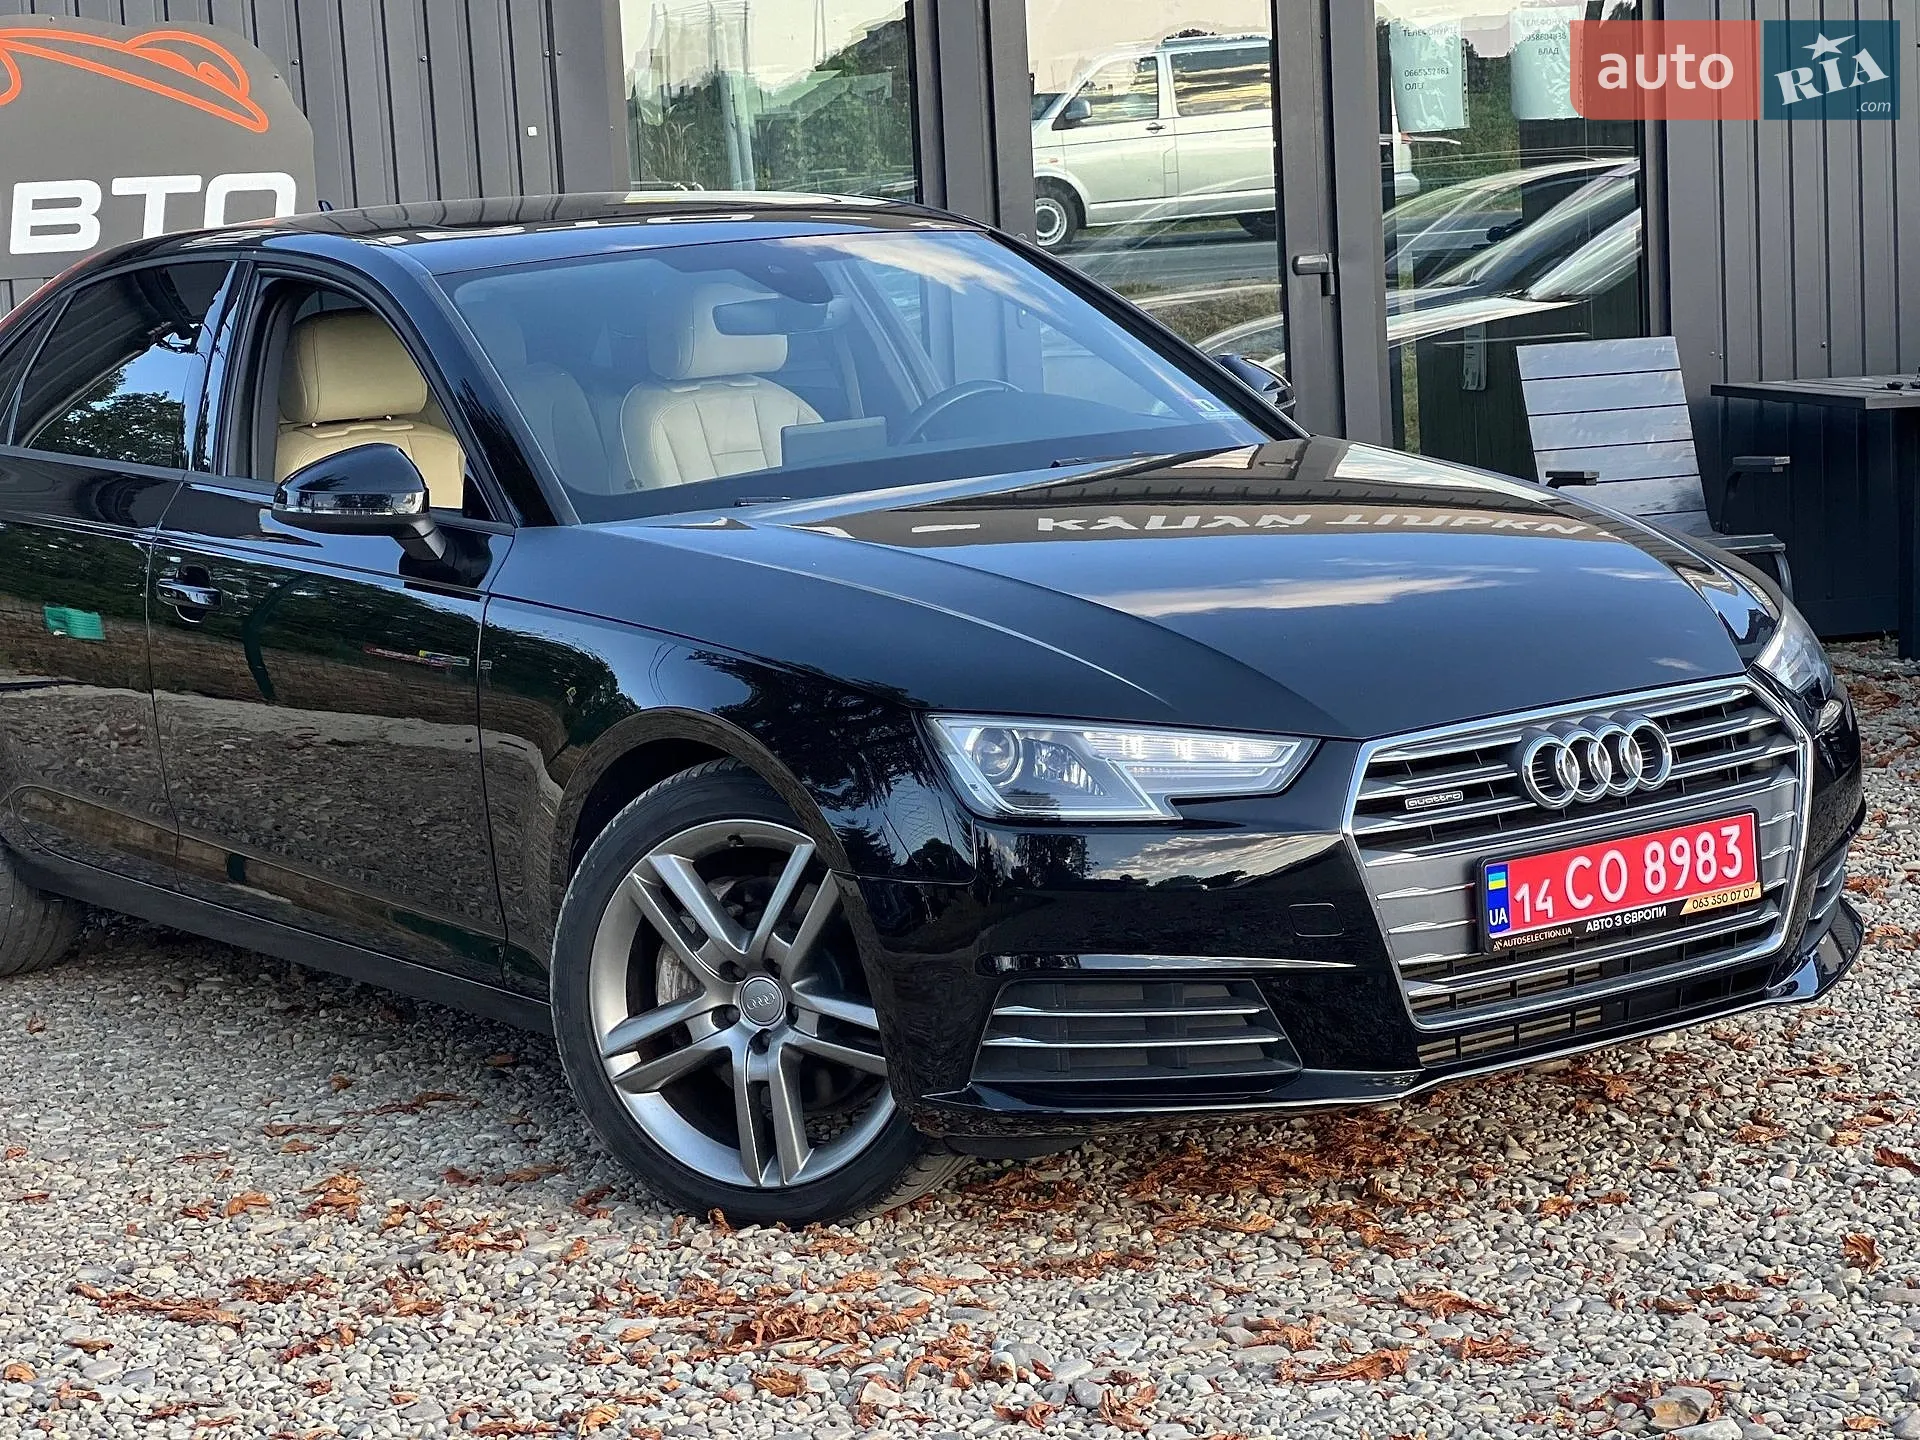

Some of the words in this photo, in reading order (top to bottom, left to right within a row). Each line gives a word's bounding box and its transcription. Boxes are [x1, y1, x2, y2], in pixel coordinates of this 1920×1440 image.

[1538, 47, 1560, 56] ВЛАД
[1404, 80, 1425, 91] ОЛЕГ
[1408, 793, 1461, 808] quattro
[1514, 878, 1554, 923] 14
[1565, 849, 1628, 910] CO
[1643, 824, 1743, 895] 8983
[1692, 896, 1709, 910] 063
[1711, 893, 1728, 906] 350
[1730, 890, 1741, 902] 07
[1743, 887, 1755, 899] 07
[1488, 907, 1508, 926] UA
[1586, 917, 1613, 933] АВТО
[1623, 905, 1667, 925] ЄВРОПИ
[1502, 926, 1573, 948] AUTOSELECTION.UA
